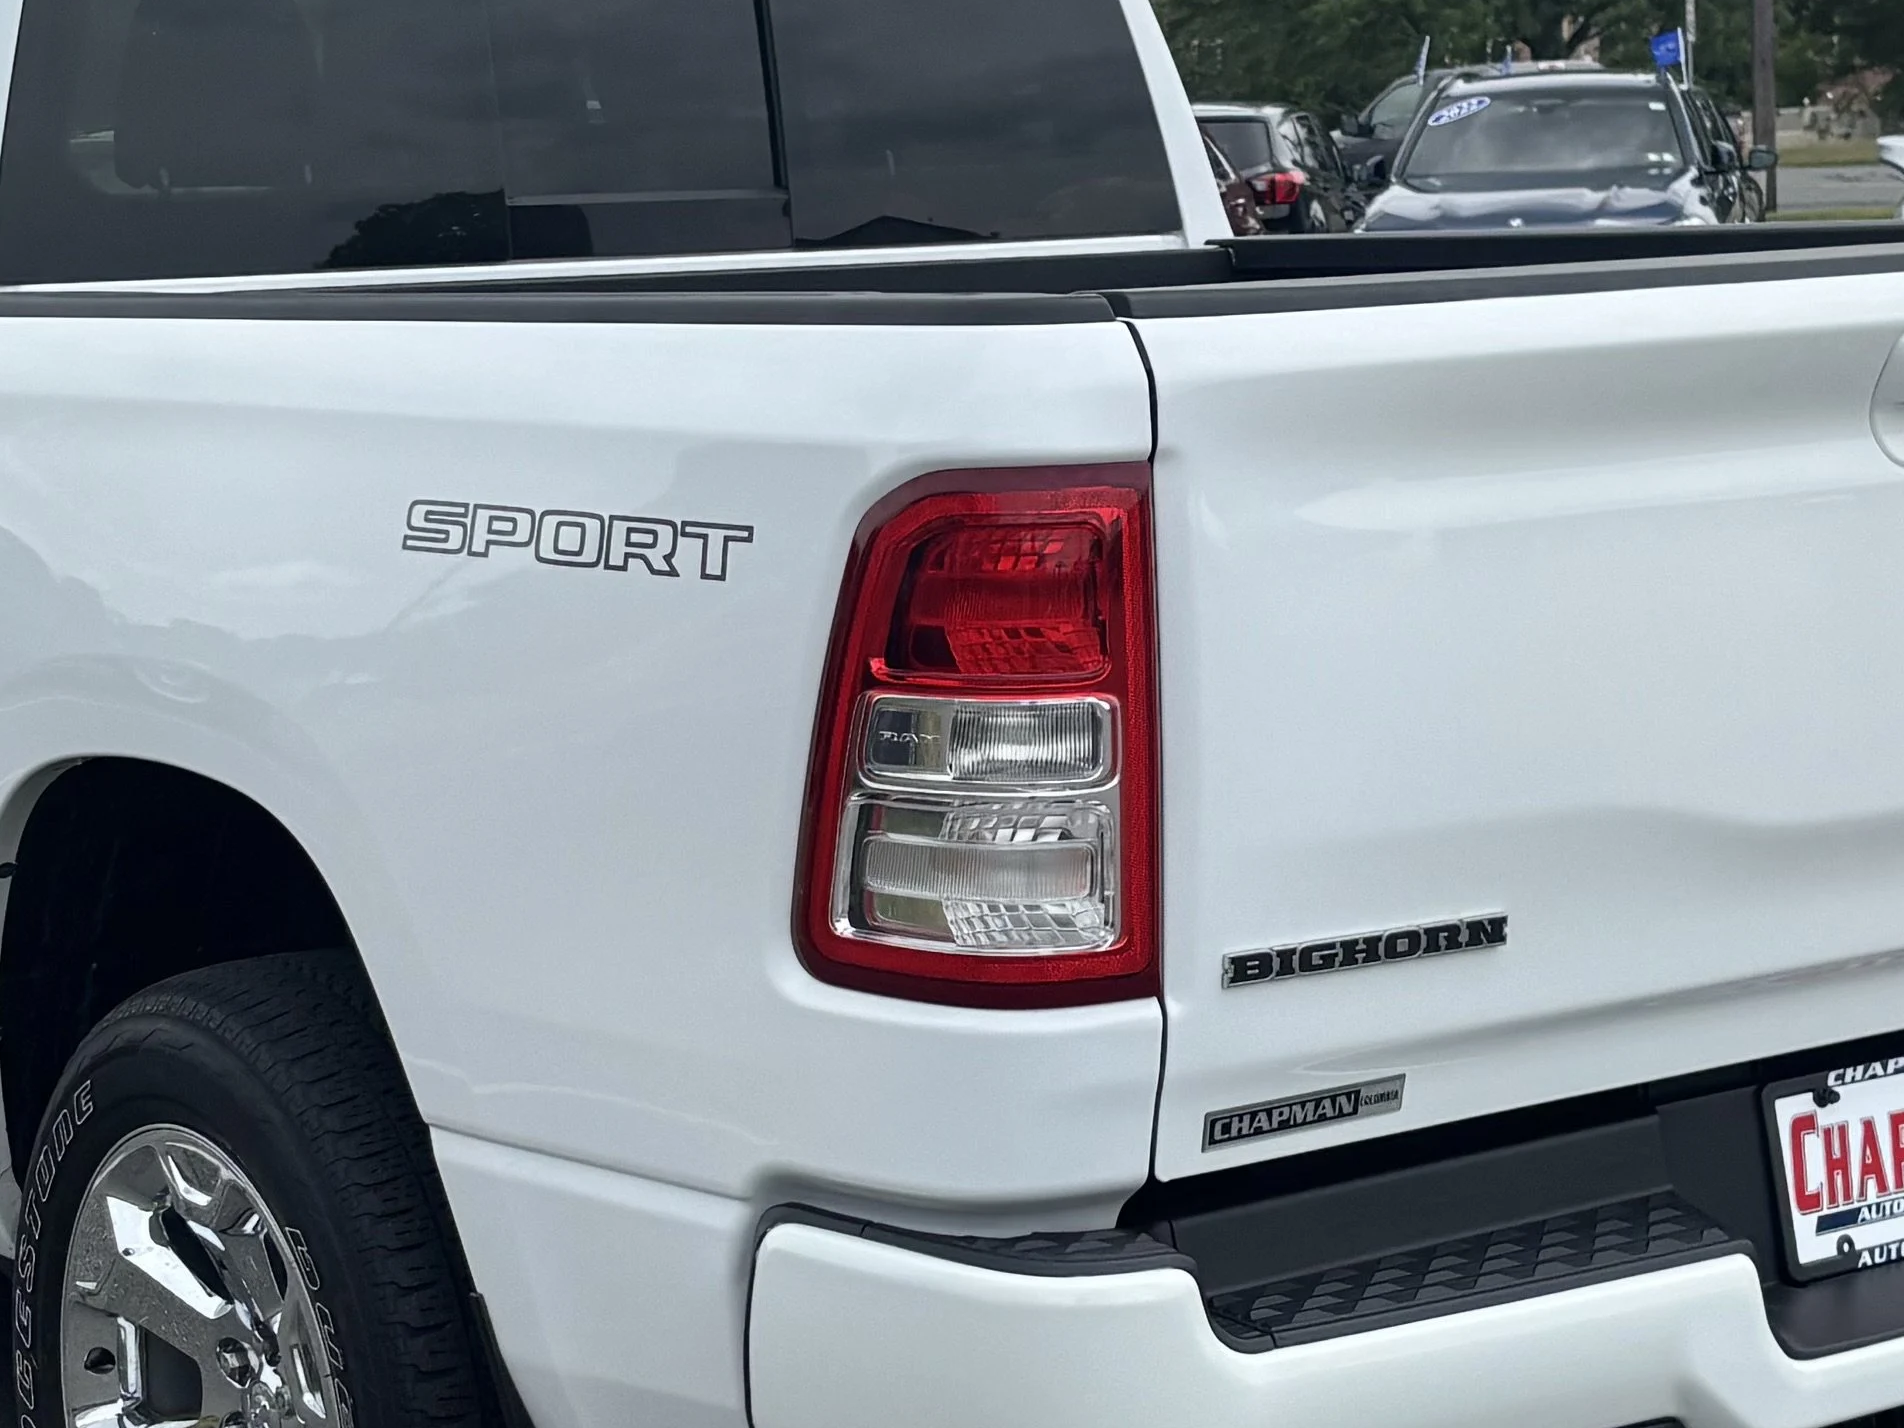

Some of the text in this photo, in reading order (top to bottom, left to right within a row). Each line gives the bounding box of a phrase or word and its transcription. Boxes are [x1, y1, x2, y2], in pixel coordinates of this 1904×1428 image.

[402, 499, 754, 581] SPORT
[1222, 915, 1508, 988] BIGHORN
[1214, 1093, 1356, 1141] CHAPMAN
